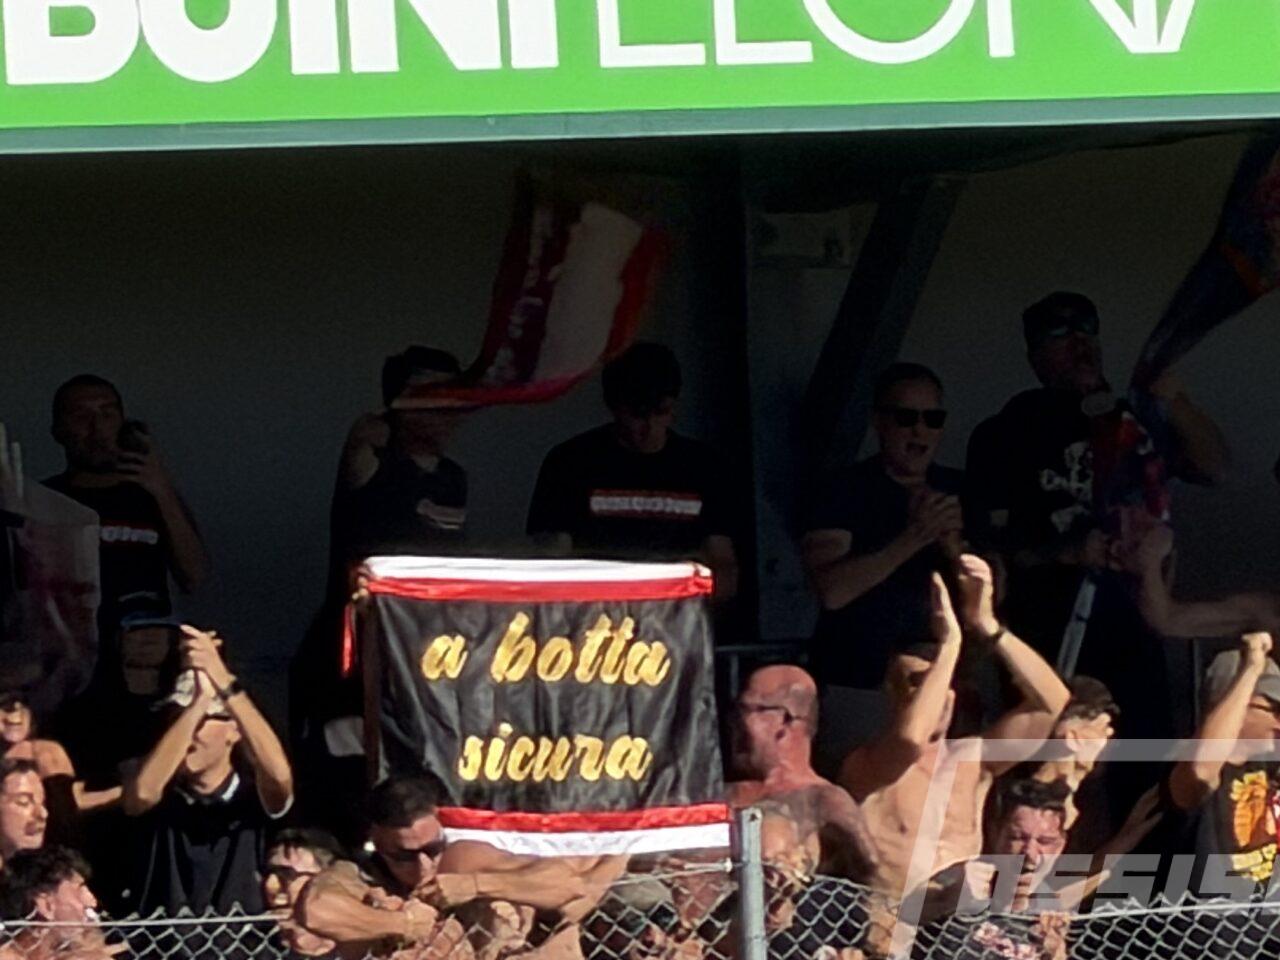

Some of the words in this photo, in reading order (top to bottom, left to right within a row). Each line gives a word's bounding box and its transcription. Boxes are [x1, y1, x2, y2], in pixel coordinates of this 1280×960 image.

[421, 633, 468, 679] a
[490, 611, 671, 686] botta
[458, 722, 653, 782] sicura
